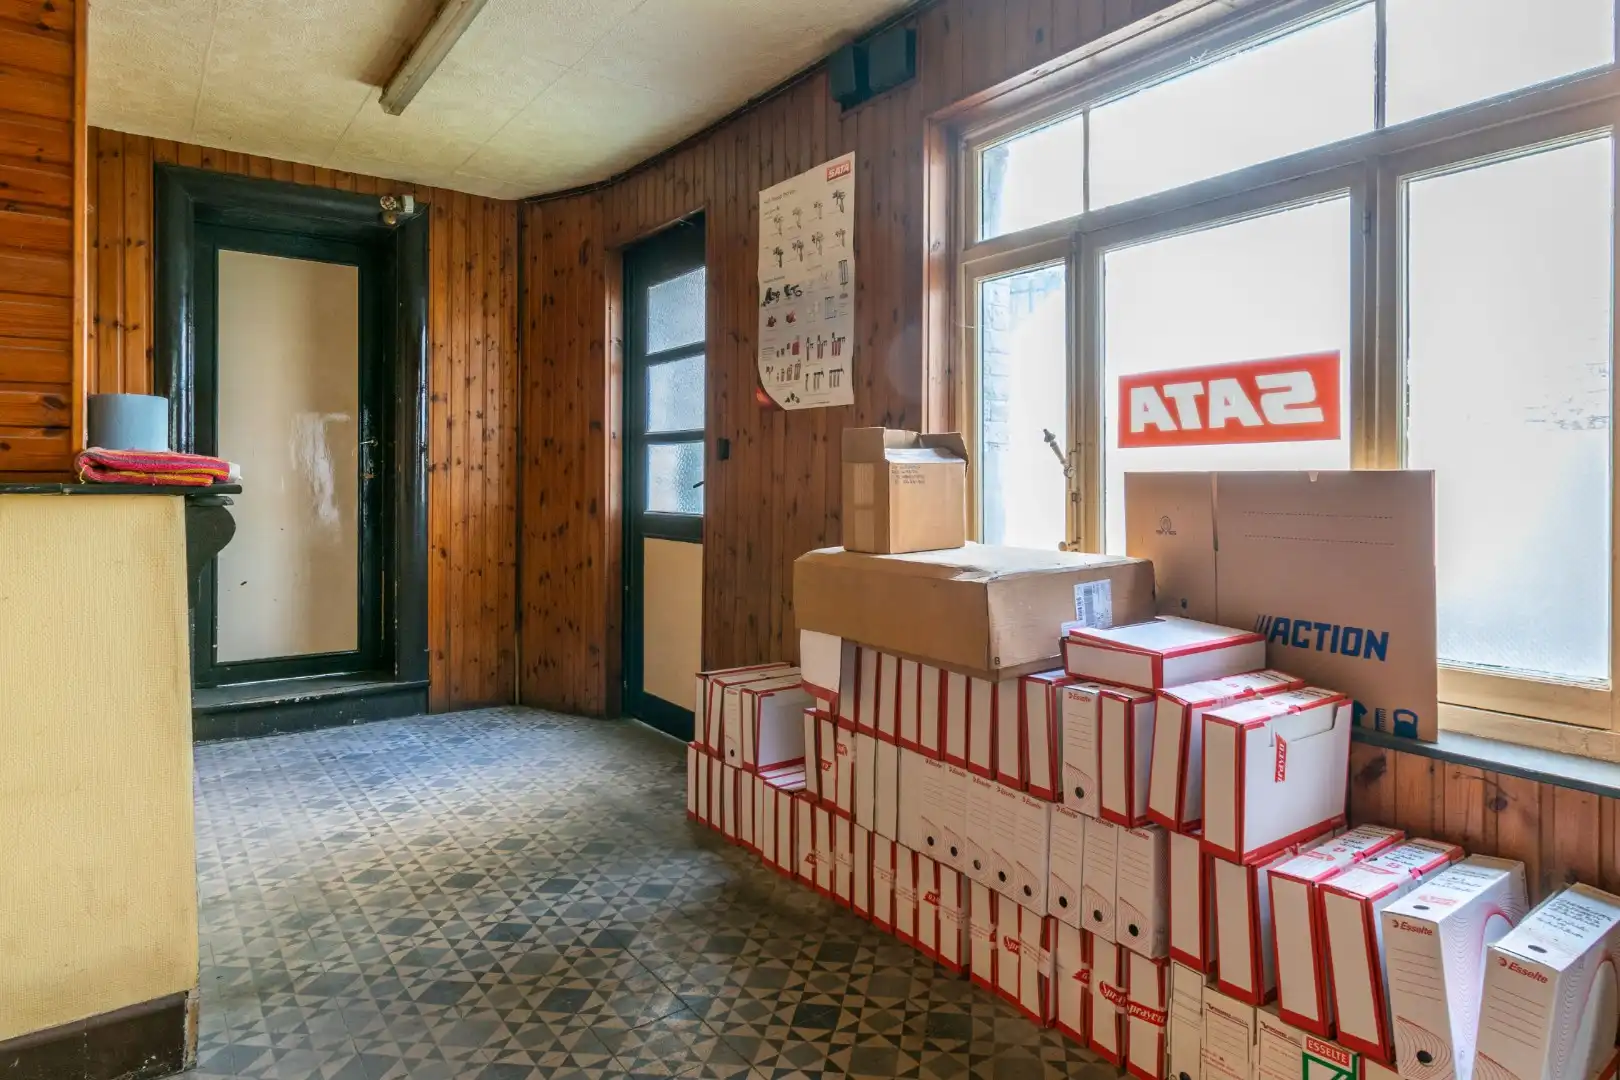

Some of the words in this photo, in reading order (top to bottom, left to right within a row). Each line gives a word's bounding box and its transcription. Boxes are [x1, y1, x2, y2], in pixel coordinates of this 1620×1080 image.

[828, 164, 850, 179] SATA
[1269, 616, 1389, 662] ACTION
[1400, 921, 1433, 936] Esselte
[1508, 961, 1549, 984] Esselte
[1308, 1039, 1348, 1064] ESSELTE
